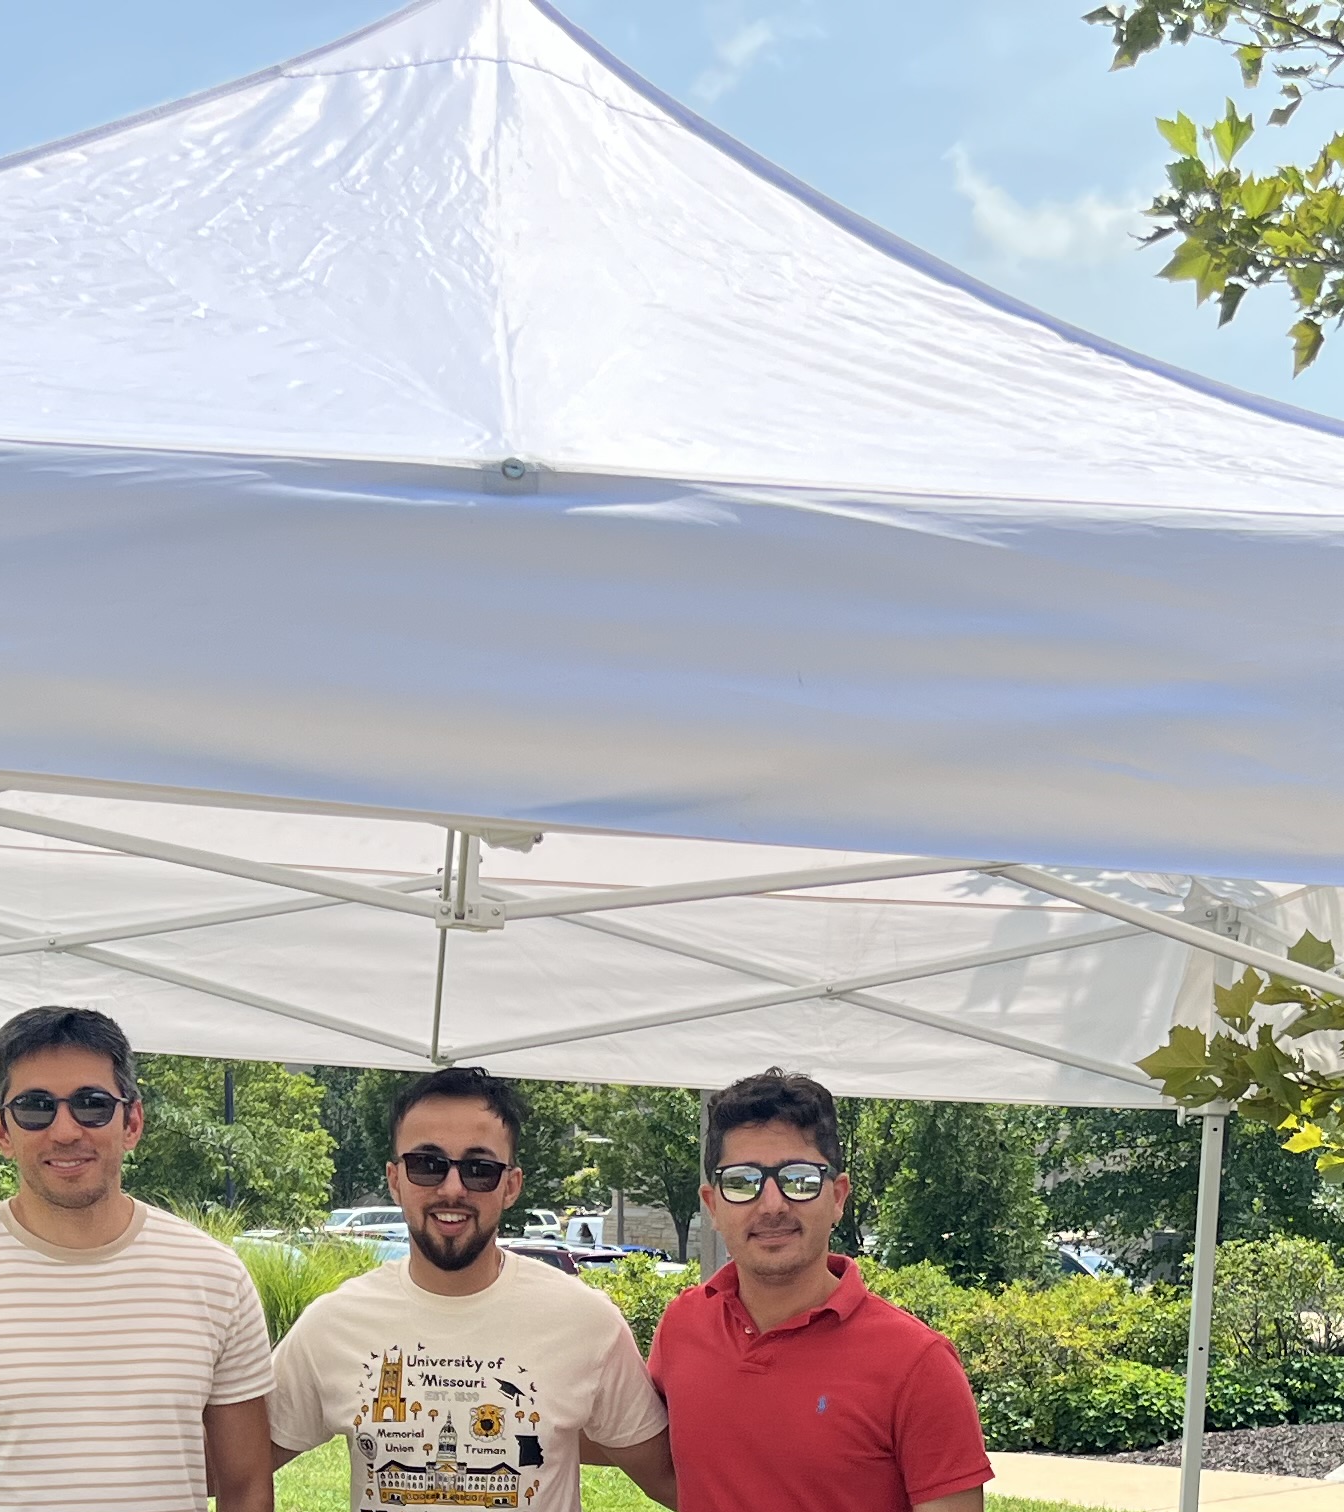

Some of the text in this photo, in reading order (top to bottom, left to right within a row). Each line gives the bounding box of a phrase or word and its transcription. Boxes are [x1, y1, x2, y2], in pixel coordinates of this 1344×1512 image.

[407, 1354, 505, 1373] University of
[422, 1374, 487, 1388] Missouri
[376, 1428, 425, 1439] Memorial
[385, 1443, 415, 1453] Union
[464, 1444, 507, 1455] Truman
